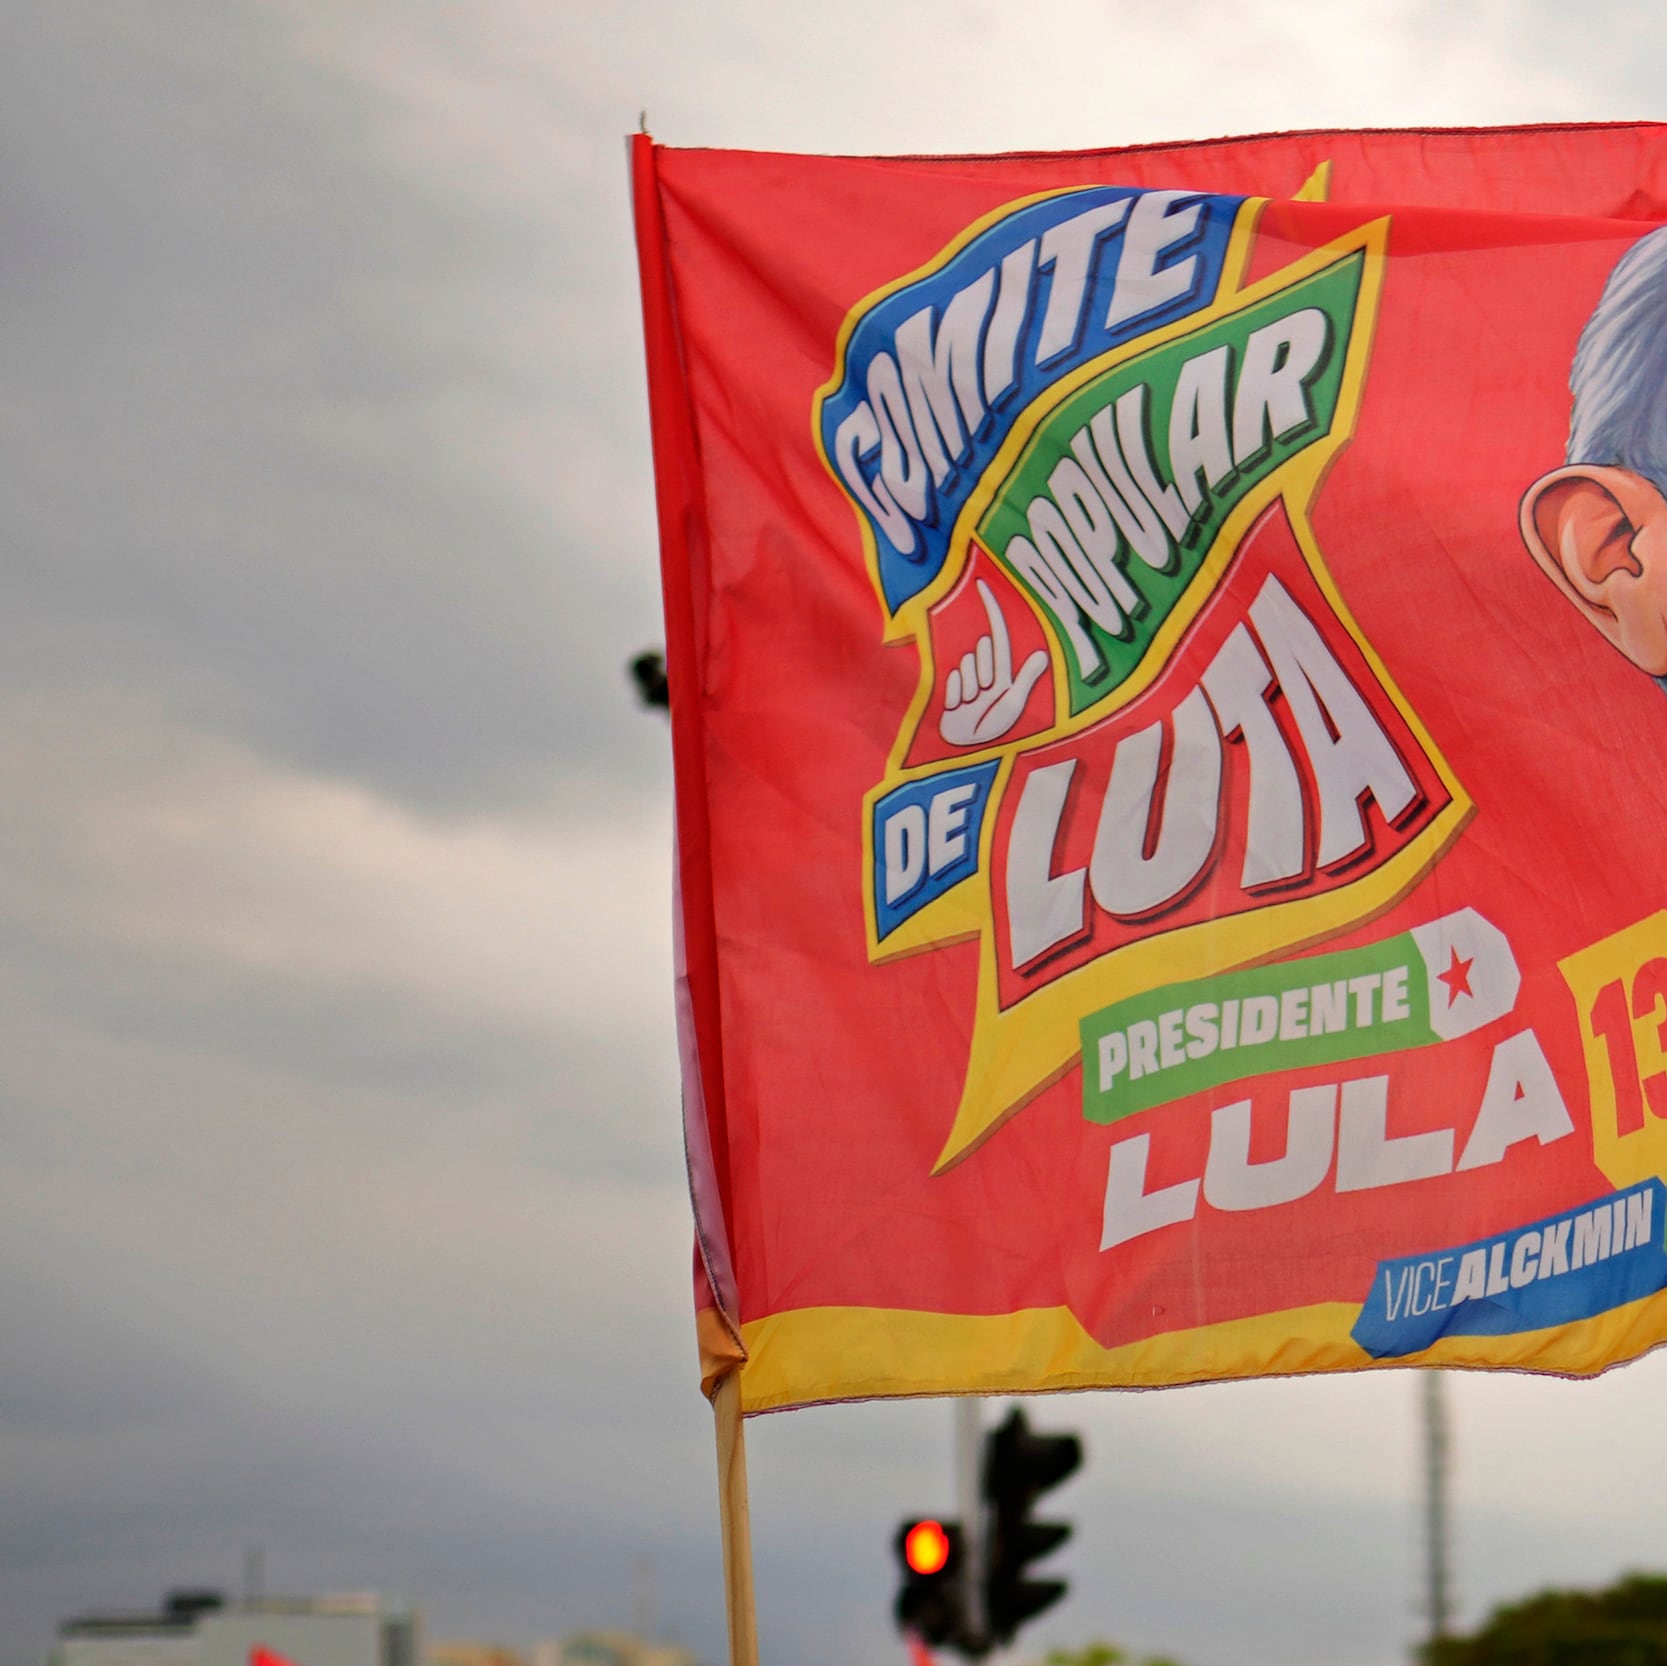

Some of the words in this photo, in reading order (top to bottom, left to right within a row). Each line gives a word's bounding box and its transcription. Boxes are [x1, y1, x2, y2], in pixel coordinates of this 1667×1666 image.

[1005, 306, 1332, 682] POPULAR
[884, 782, 981, 906] DE
[1005, 571, 1420, 972] LUTA
[1098, 965, 1411, 1093] PRESIDENTE
[1100, 1027, 1574, 1252] LULA
